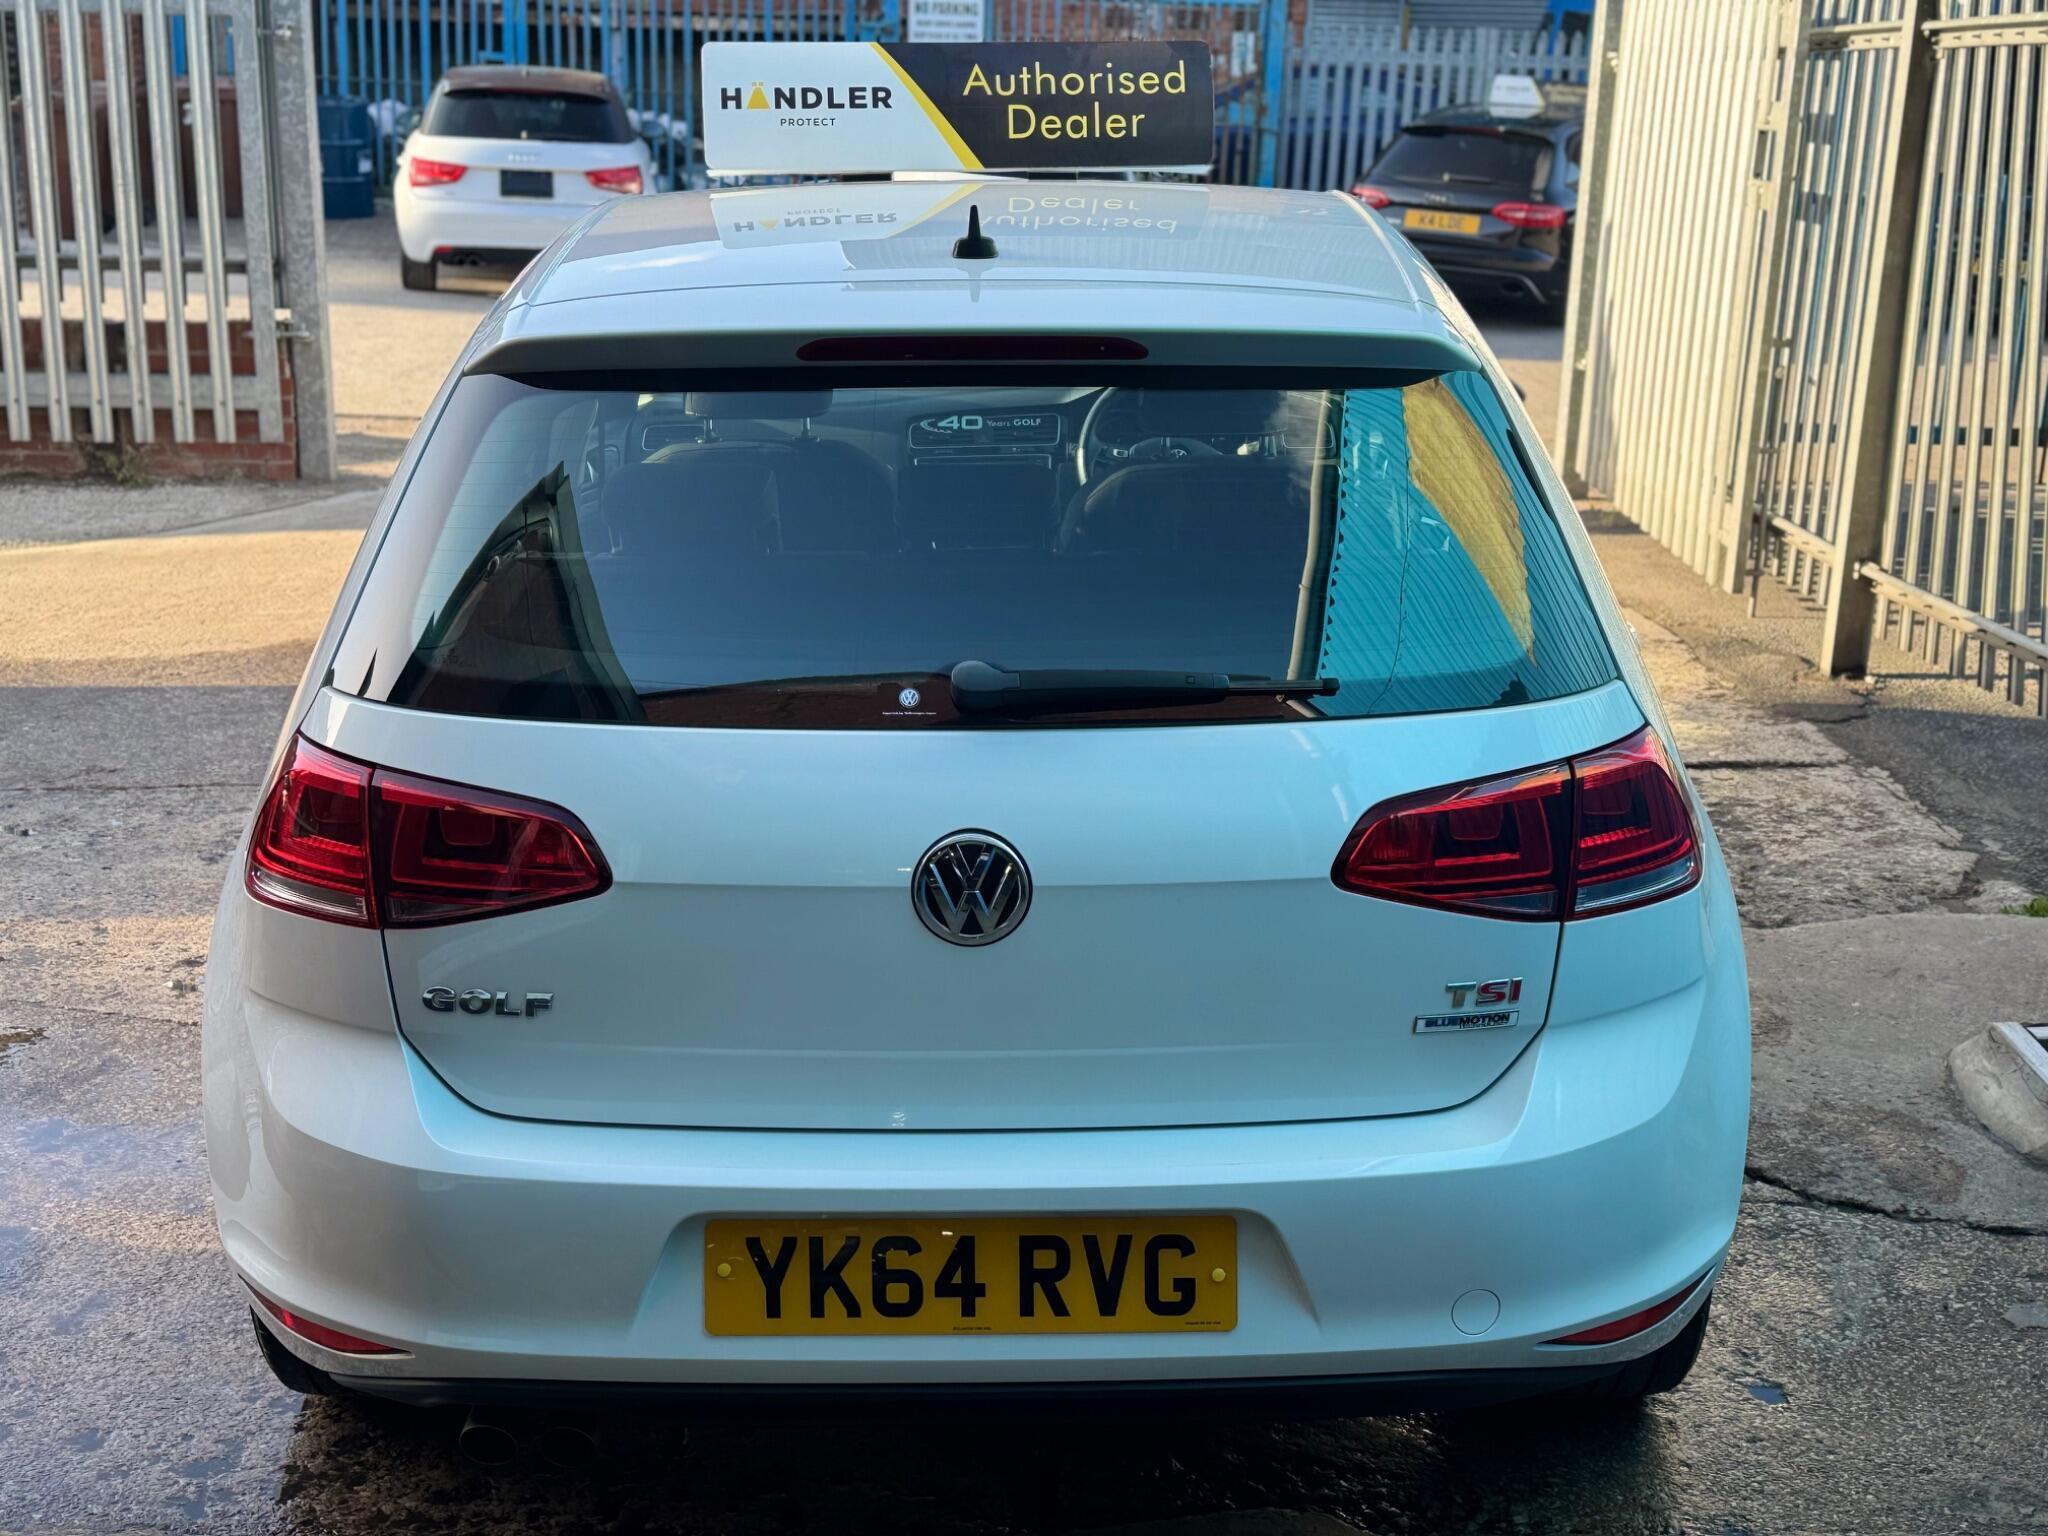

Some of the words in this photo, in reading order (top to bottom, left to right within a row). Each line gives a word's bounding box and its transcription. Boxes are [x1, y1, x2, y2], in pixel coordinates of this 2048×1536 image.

[962, 60, 1186, 96] Authorised
[780, 117, 836, 126] PROTECT
[1008, 101, 1145, 139] Dealer
[1013, 418, 1041, 426] GOLF
[422, 986, 553, 1017] GOLF
[1445, 977, 1523, 1009] TSI
[745, 1234, 987, 1319] YK64
[1018, 1233, 1197, 1318] RVG
